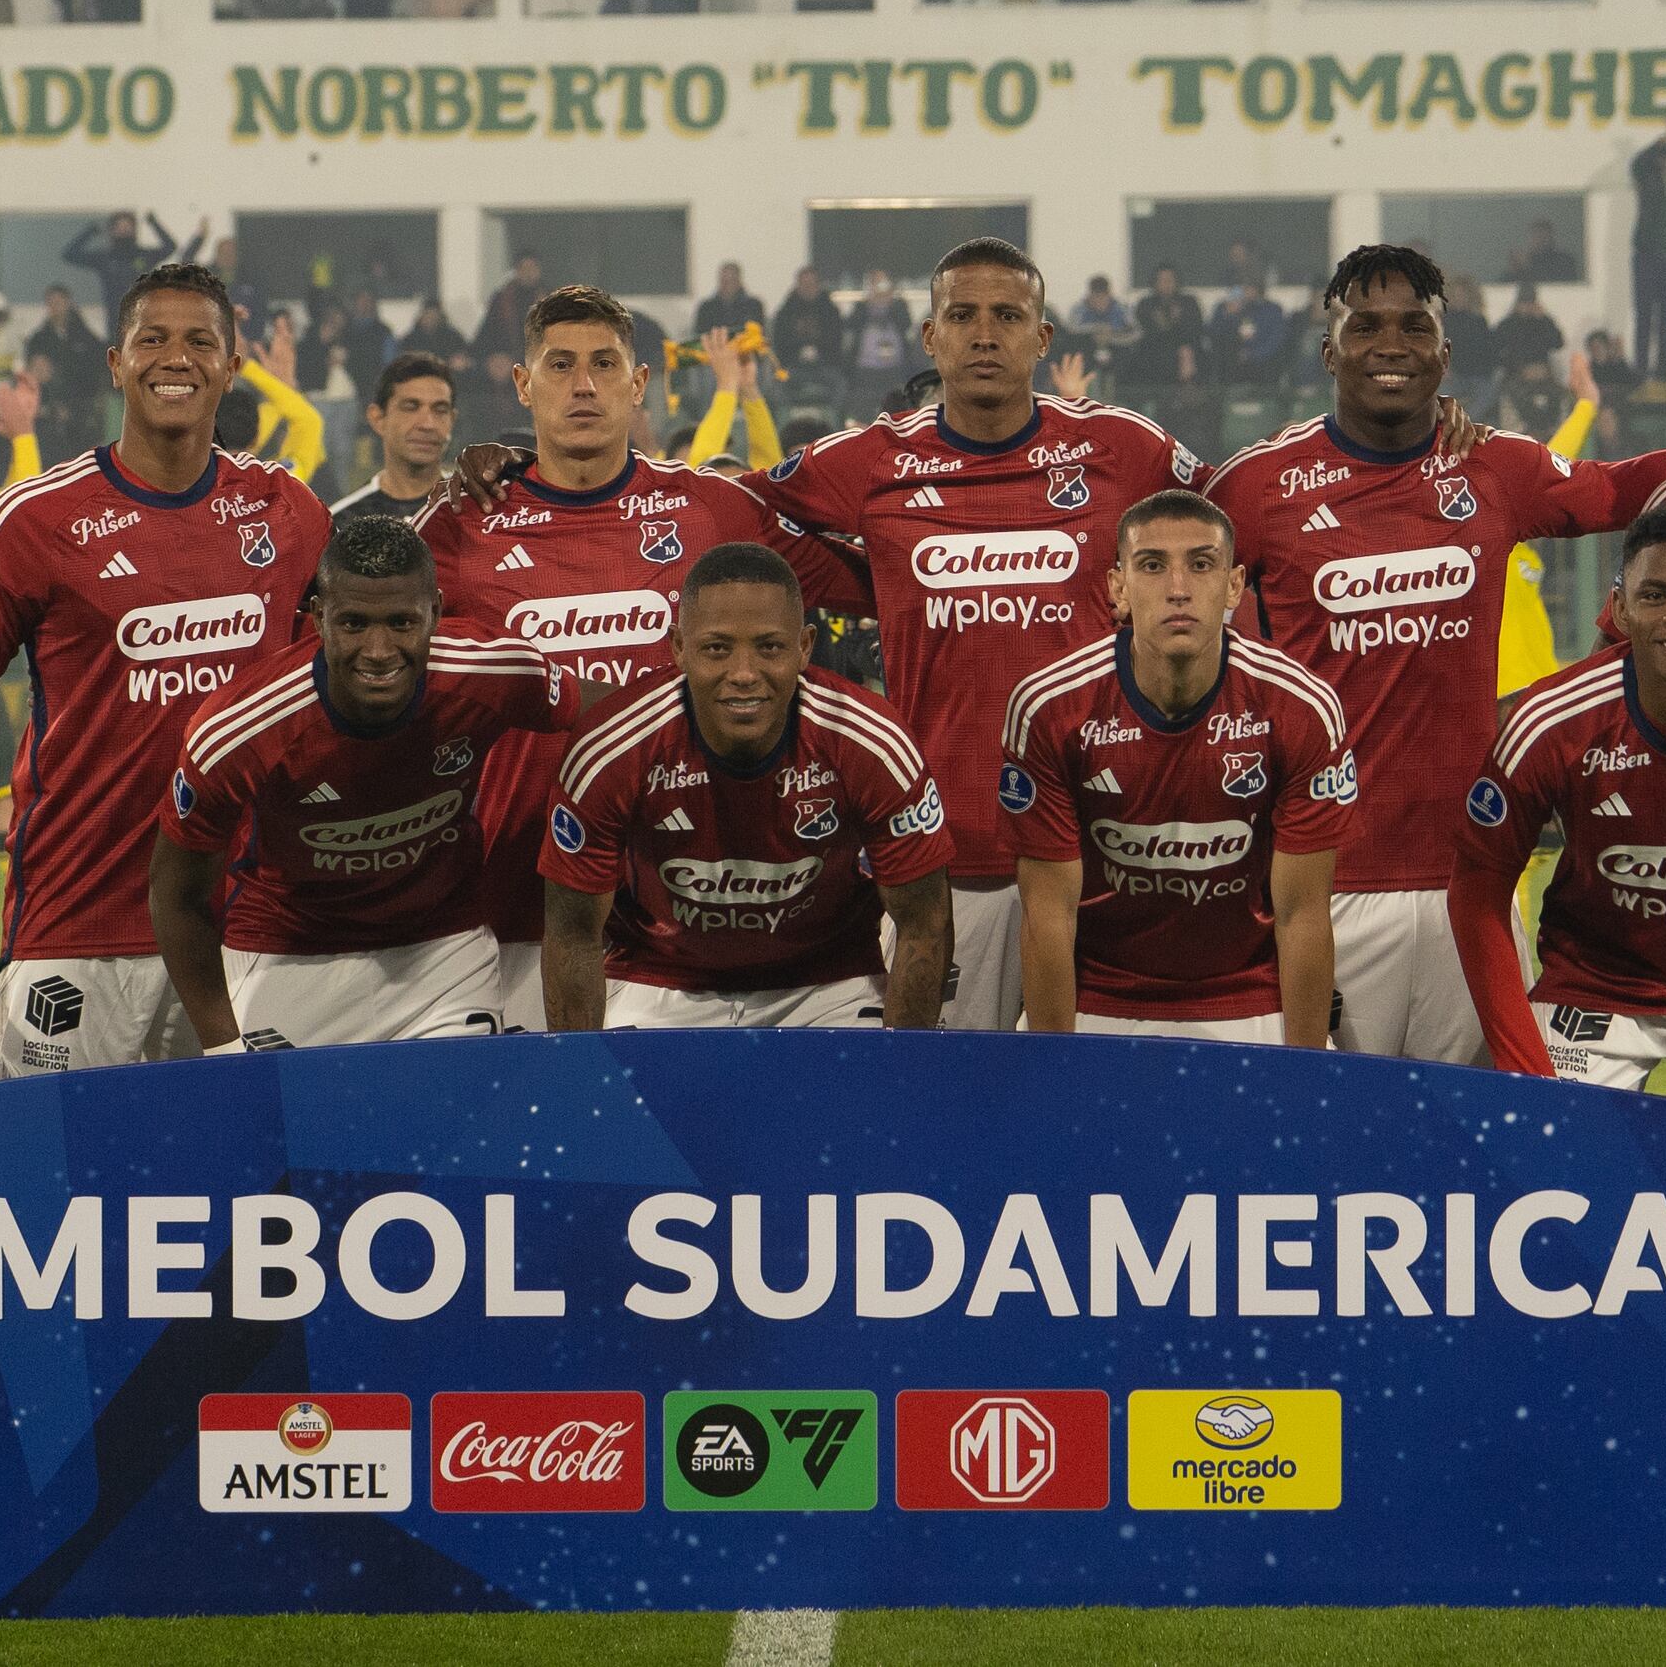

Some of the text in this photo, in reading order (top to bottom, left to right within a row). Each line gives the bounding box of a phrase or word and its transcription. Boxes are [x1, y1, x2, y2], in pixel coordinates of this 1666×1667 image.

[231, 63, 727, 139] NORBERTO
[893, 453, 963, 479] Pilsen
[1027, 441, 1094, 469] Pilsen
[1279, 466, 1351, 498] Pilsen
[211, 496, 269, 525] Pilsen
[481, 509, 553, 535] Pilsen
[618, 492, 689, 521] Pilsen
[71, 510, 141, 545] Pilsen
[916, 545, 1073, 577] Colanta
[1318, 562, 1470, 601] Colanta
[508, 605, 667, 642] Colanta
[926, 590, 1073, 632] Wplay.co
[122, 607, 264, 648] Colanta
[1329, 612, 1470, 655] Wplay.co
[1582, 745, 1651, 775] Pilsen
[647, 762, 710, 795] Pilsen
[303, 795, 459, 845] Colanta
[893, 780, 942, 833] tigo
[1096, 828, 1248, 860] Colanta
[664, 864, 817, 895] Colanta
[1104, 862, 1247, 905] Wplay.co
[23, 1049, 70, 1062] INTELIGENTE
[24, 1038, 71, 1055] LOGÍSTICA
[1547, 1044, 1589, 1058] OGÍSTICA
[1550, 1053, 1588, 1066] TELIGENTE
[22, 1055, 69, 1072] SOLUTION
[1553, 1061, 1588, 1074] LUTION
[289, 1421, 322, 1430] AMSTEL
[694, 1425, 753, 1456] EA
[440, 1420, 635, 1483] Coca-Cola
[691, 1457, 755, 1473] SPORTS
[961, 1408, 1046, 1492] MG
[223, 1462, 389, 1501] AMSTEL
[1173, 1454, 1297, 1481] mercado
[1204, 1478, 1266, 1505] libre
